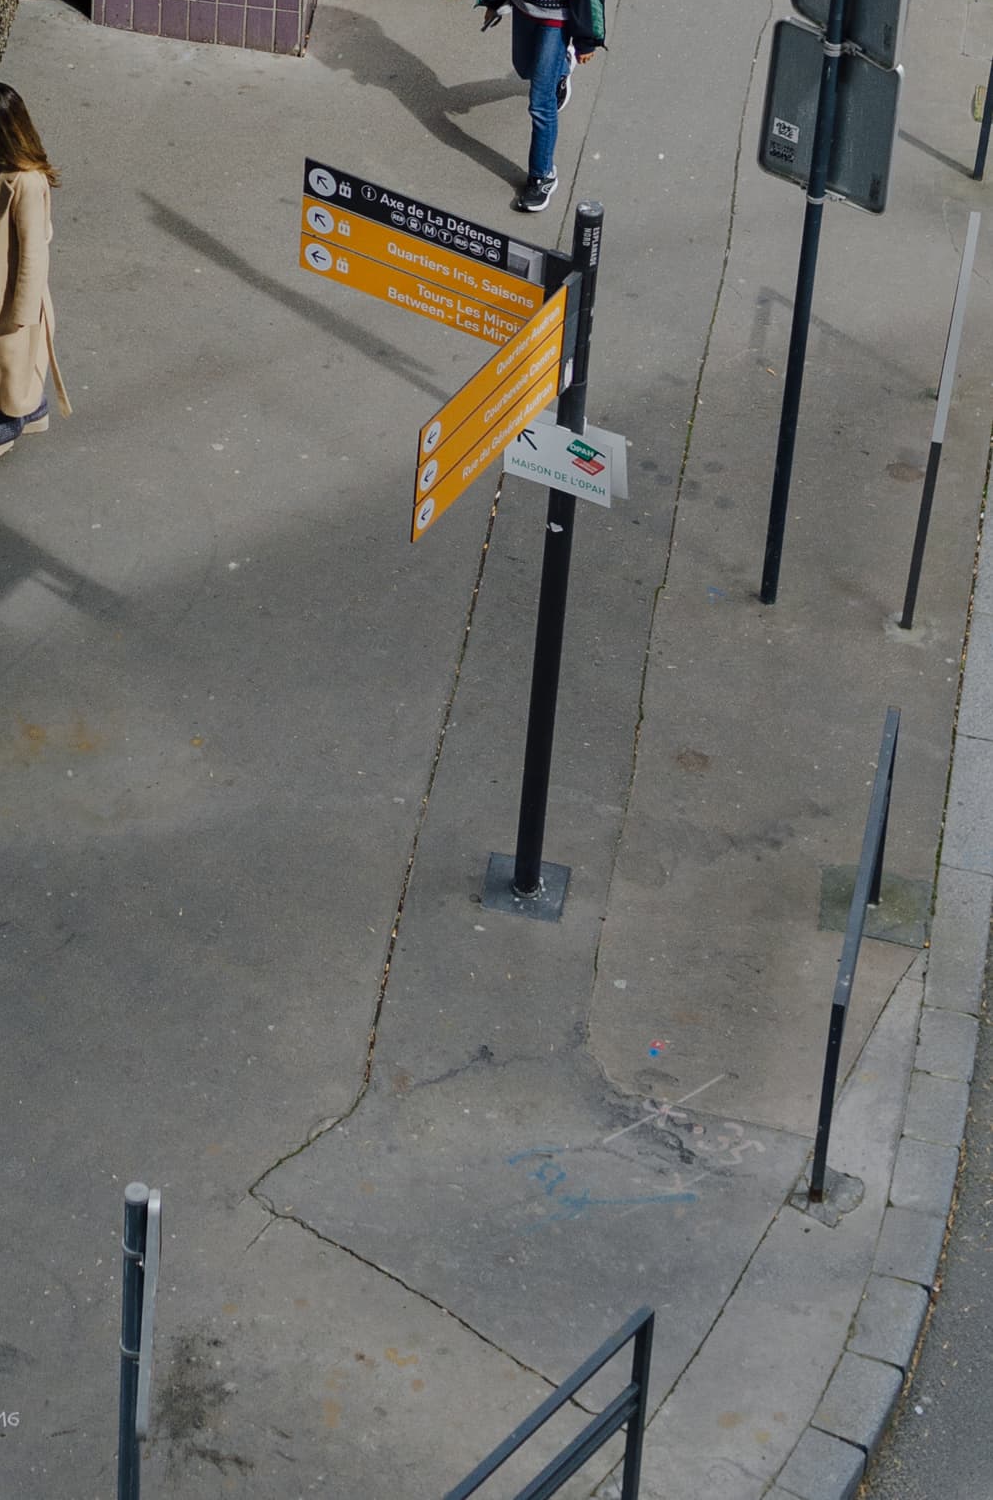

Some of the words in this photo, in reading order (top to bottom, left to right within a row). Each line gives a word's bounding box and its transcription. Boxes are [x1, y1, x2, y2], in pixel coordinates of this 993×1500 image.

[379, 193, 405, 211] Axe
[407, 204, 424, 218] de
[427, 210, 444, 226] La
[447, 218, 502, 249] Défense
[454, 238, 467, 247] BUS
[582, 227, 592, 247] NORD
[590, 227, 600, 267] ESPLANADE
[387, 242, 450, 276] Quartiers
[453, 267, 479, 288] Iris,
[482, 278, 535, 309] Saisons
[388, 285, 445, 319] Between
[456, 313, 479, 332] Les
[417, 283, 454, 308] Tours
[457, 299, 481, 319] Les
[485, 310, 521, 334] Miroi
[496, 336, 530, 375] Quartier
[483, 372, 529, 423] Courbevoie
[529, 346, 557, 378] Centre
[462, 458, 479, 481] Rue
[479, 447, 491, 463] du
[491, 412, 523, 449] Général
[568, 443, 595, 458] OPAH
[511, 457, 551, 477] MAISON
[554, 471, 567, 483] DE
[570, 474, 606, 496] L'OPAH
